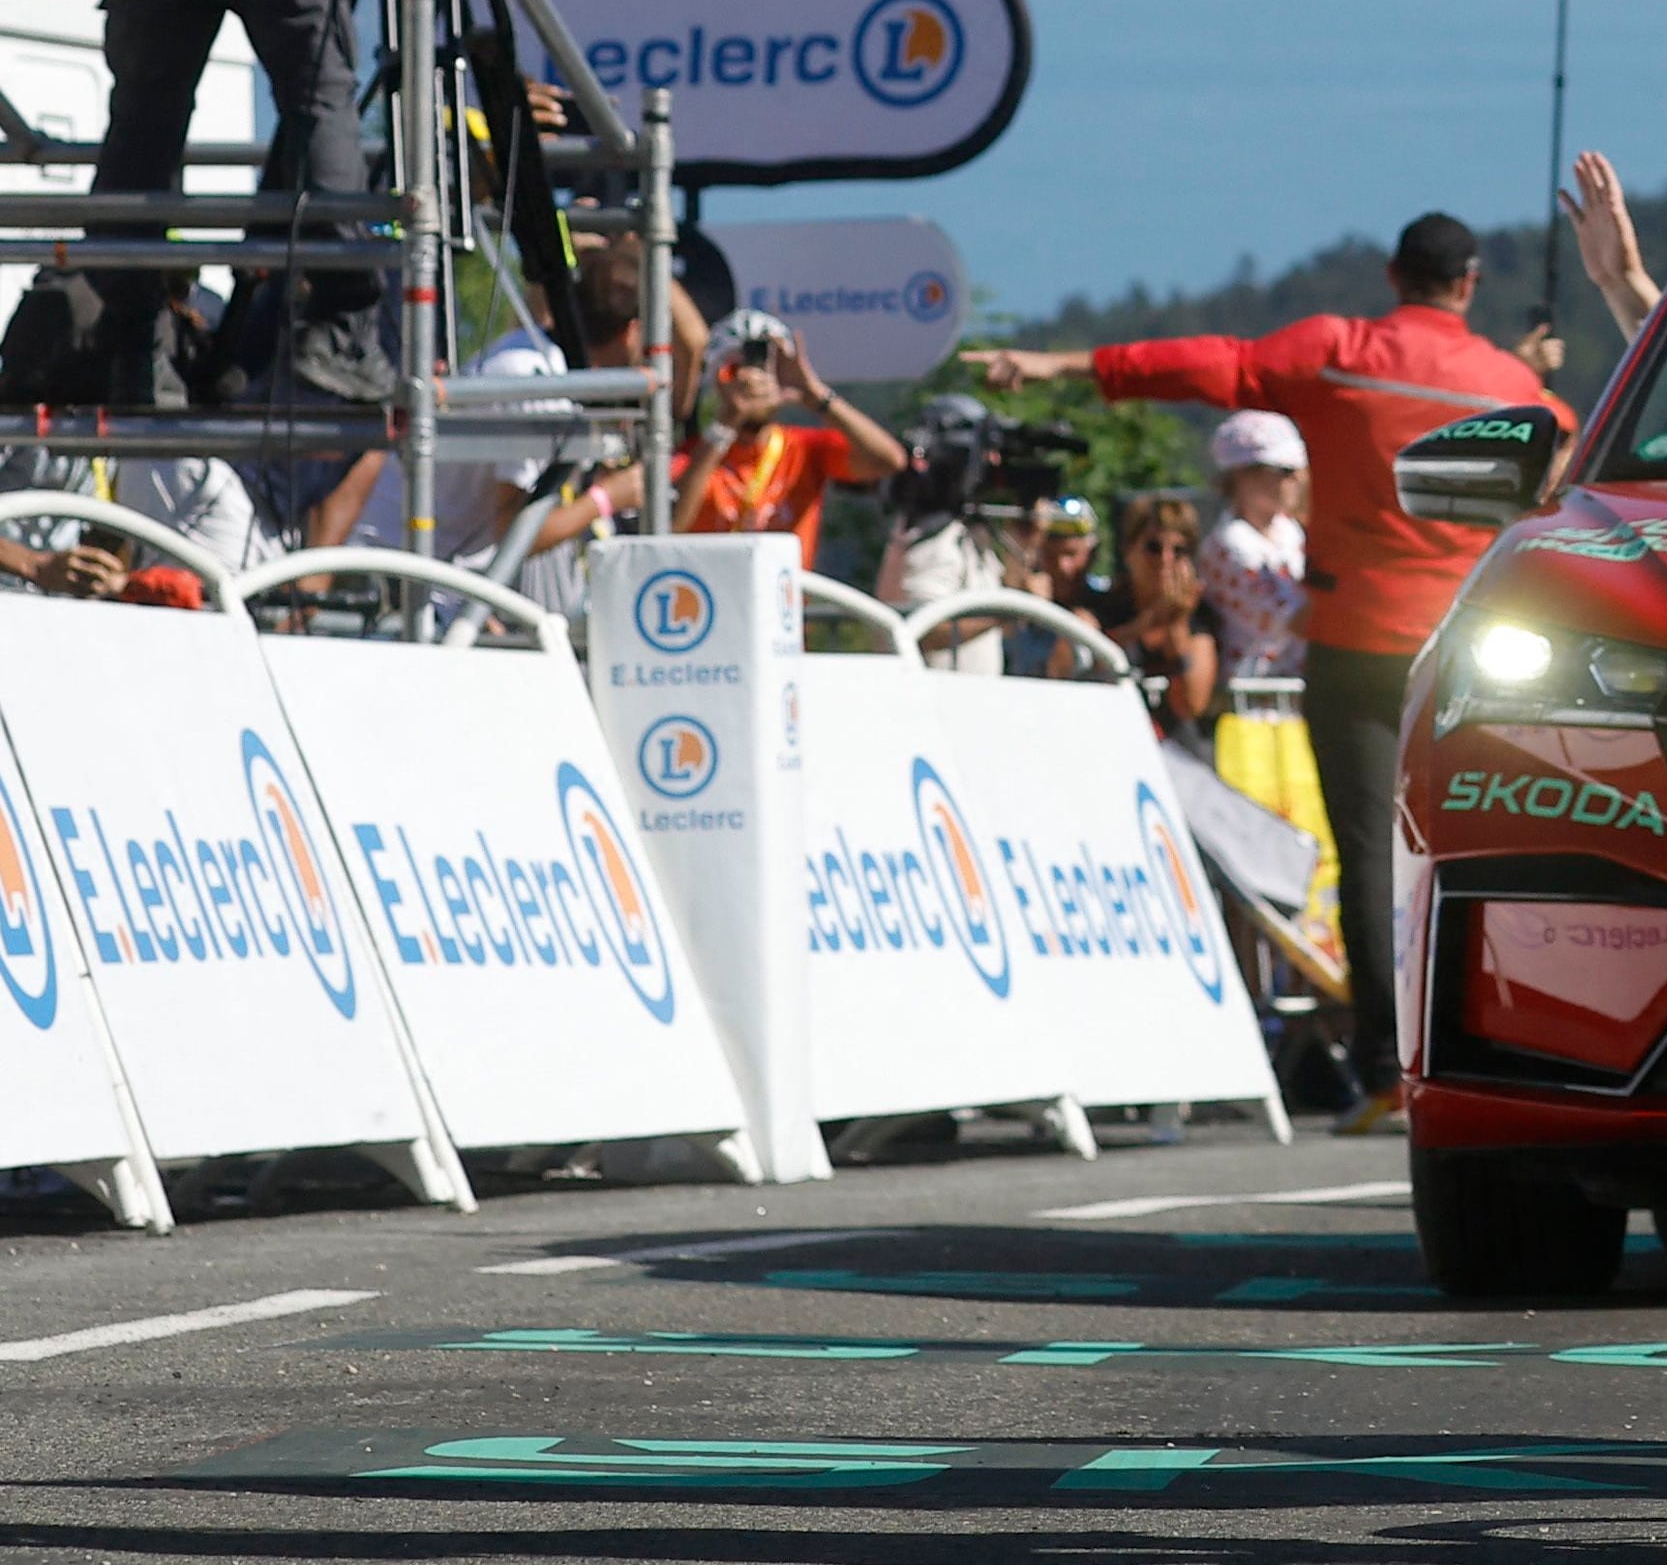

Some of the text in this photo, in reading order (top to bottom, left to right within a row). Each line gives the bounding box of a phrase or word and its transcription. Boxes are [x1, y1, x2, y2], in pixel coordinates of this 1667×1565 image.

[50, 807, 291, 965] E.Leclerc
[352, 822, 602, 968] E.Leclerc
[806, 826, 944, 952] eclerc
[995, 838, 1173, 956] E.Leclerc
